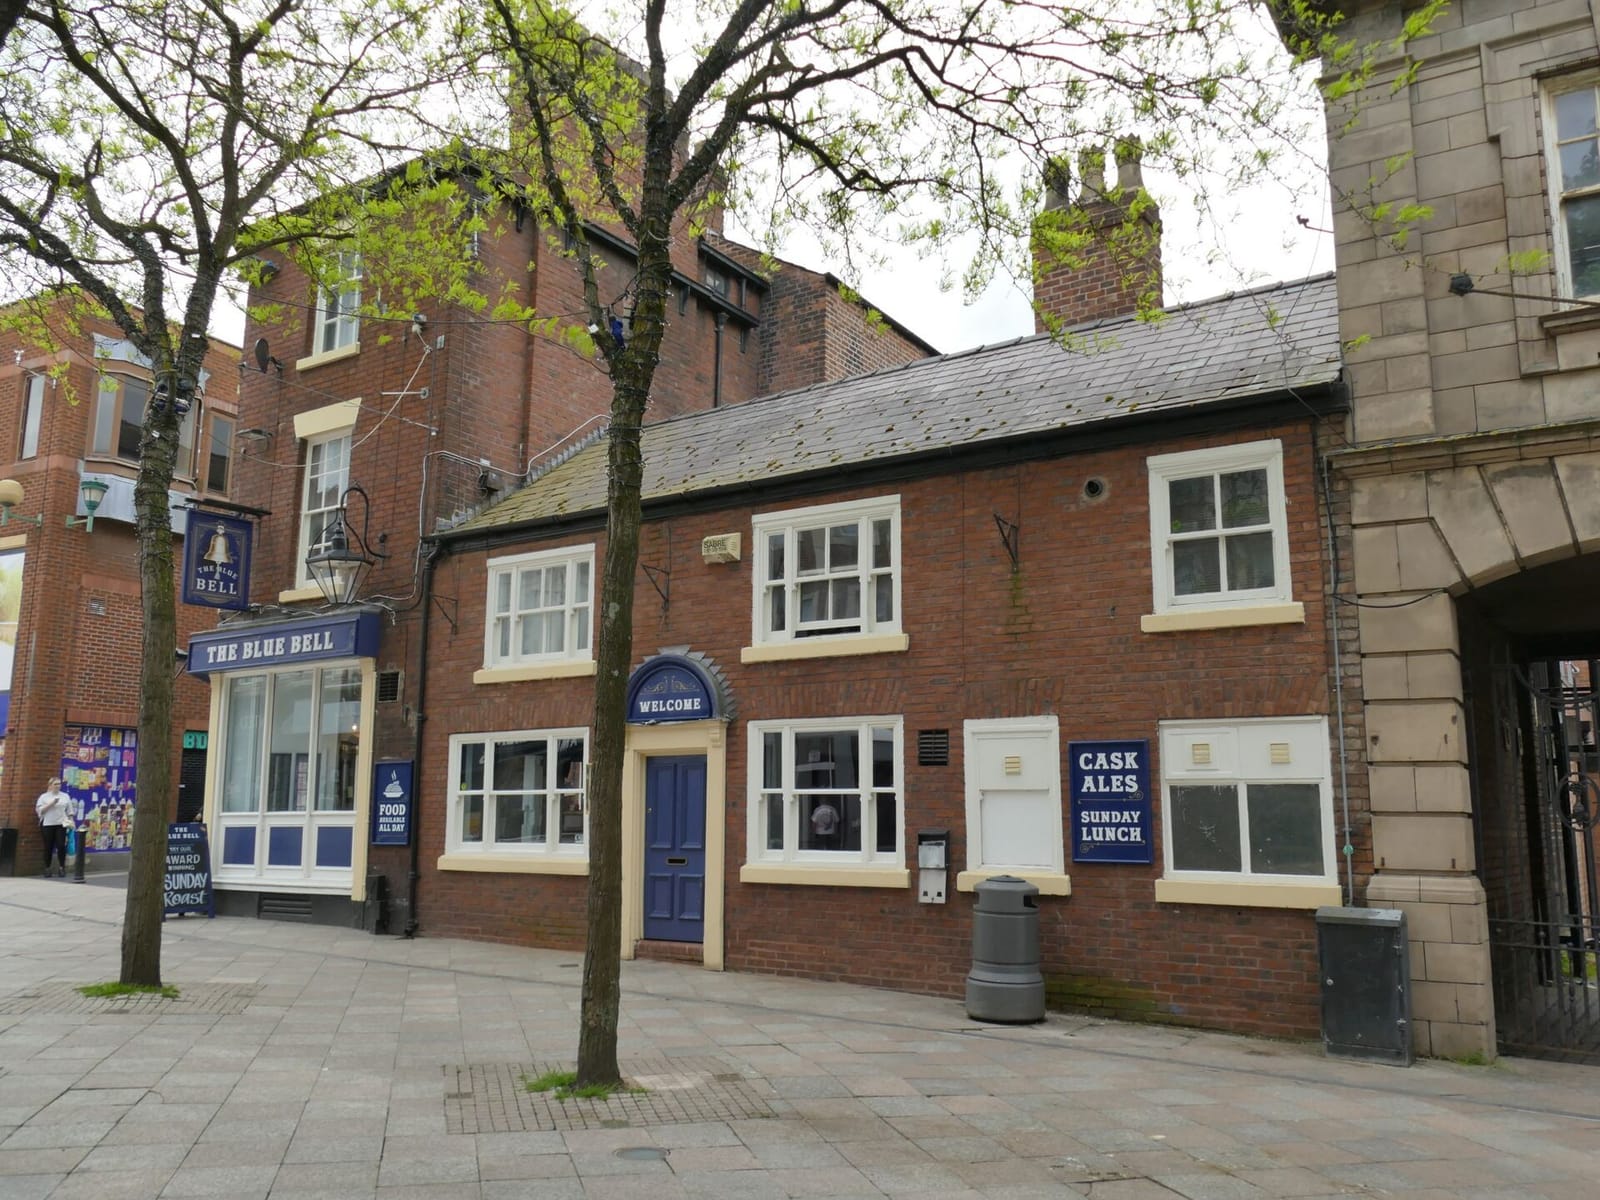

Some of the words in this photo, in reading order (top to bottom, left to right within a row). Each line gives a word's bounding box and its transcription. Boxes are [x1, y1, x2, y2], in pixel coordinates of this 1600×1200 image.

[197, 565, 215, 574] THE
[216, 565, 239, 580] BLUE
[196, 578, 237, 595] BELL
[207, 644, 238, 663] THE
[242, 638, 286, 659] BLUE
[290, 632, 334, 653] BELL
[639, 698, 702, 713] WELCOME
[1079, 752, 1139, 770] CASK
[1081, 774, 1139, 793] ALES
[379, 804, 406, 815] FOOD
[1080, 811, 1141, 823] SUNDAY
[379, 824, 391, 832] ALL
[392, 824, 405, 832] DAY
[1081, 827, 1142, 842] LUNCH
[164, 873, 208, 891] SUNDAY
[163, 890, 207, 907] Roast
